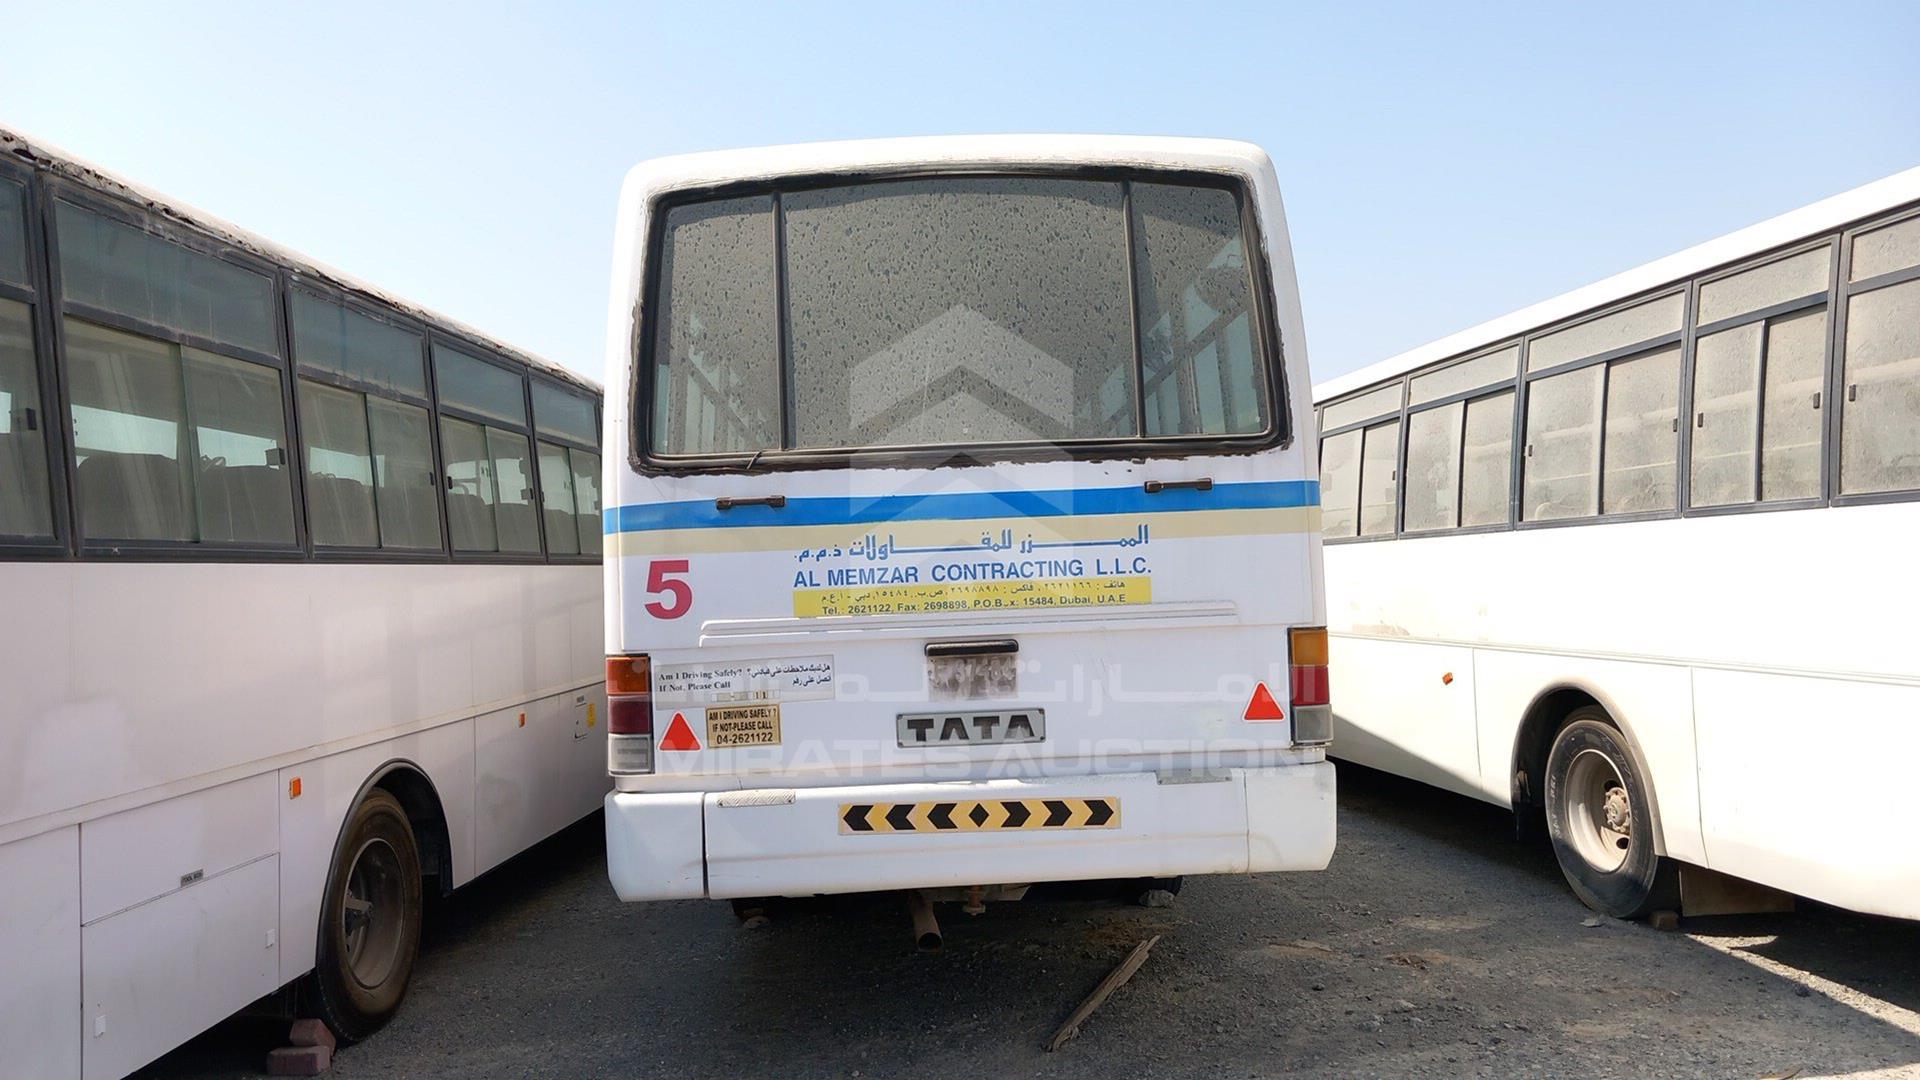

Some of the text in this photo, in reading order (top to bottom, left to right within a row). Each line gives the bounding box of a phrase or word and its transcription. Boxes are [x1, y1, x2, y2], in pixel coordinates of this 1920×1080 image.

[793, 557, 1152, 588] AL MEMZAR CONTRACTING L.L.C.
[644, 559, 693, 620] 5
[659, 673, 673, 681] Am
[682, 671, 712, 680] Driving
[714, 668, 742, 678] Safely?
[659, 684, 666, 692] If
[688, 682, 712, 691] Please
[714, 681, 731, 689] Call
[709, 711, 718, 721] AM
[723, 710, 749, 720] DRIVING
[749, 708, 771, 719] SAFELY
[713, 723, 718, 732] IF
[757, 720, 773, 730] CALL
[907, 714, 1035, 742] TATA
[717, 732, 773, 744] 04-2621122
